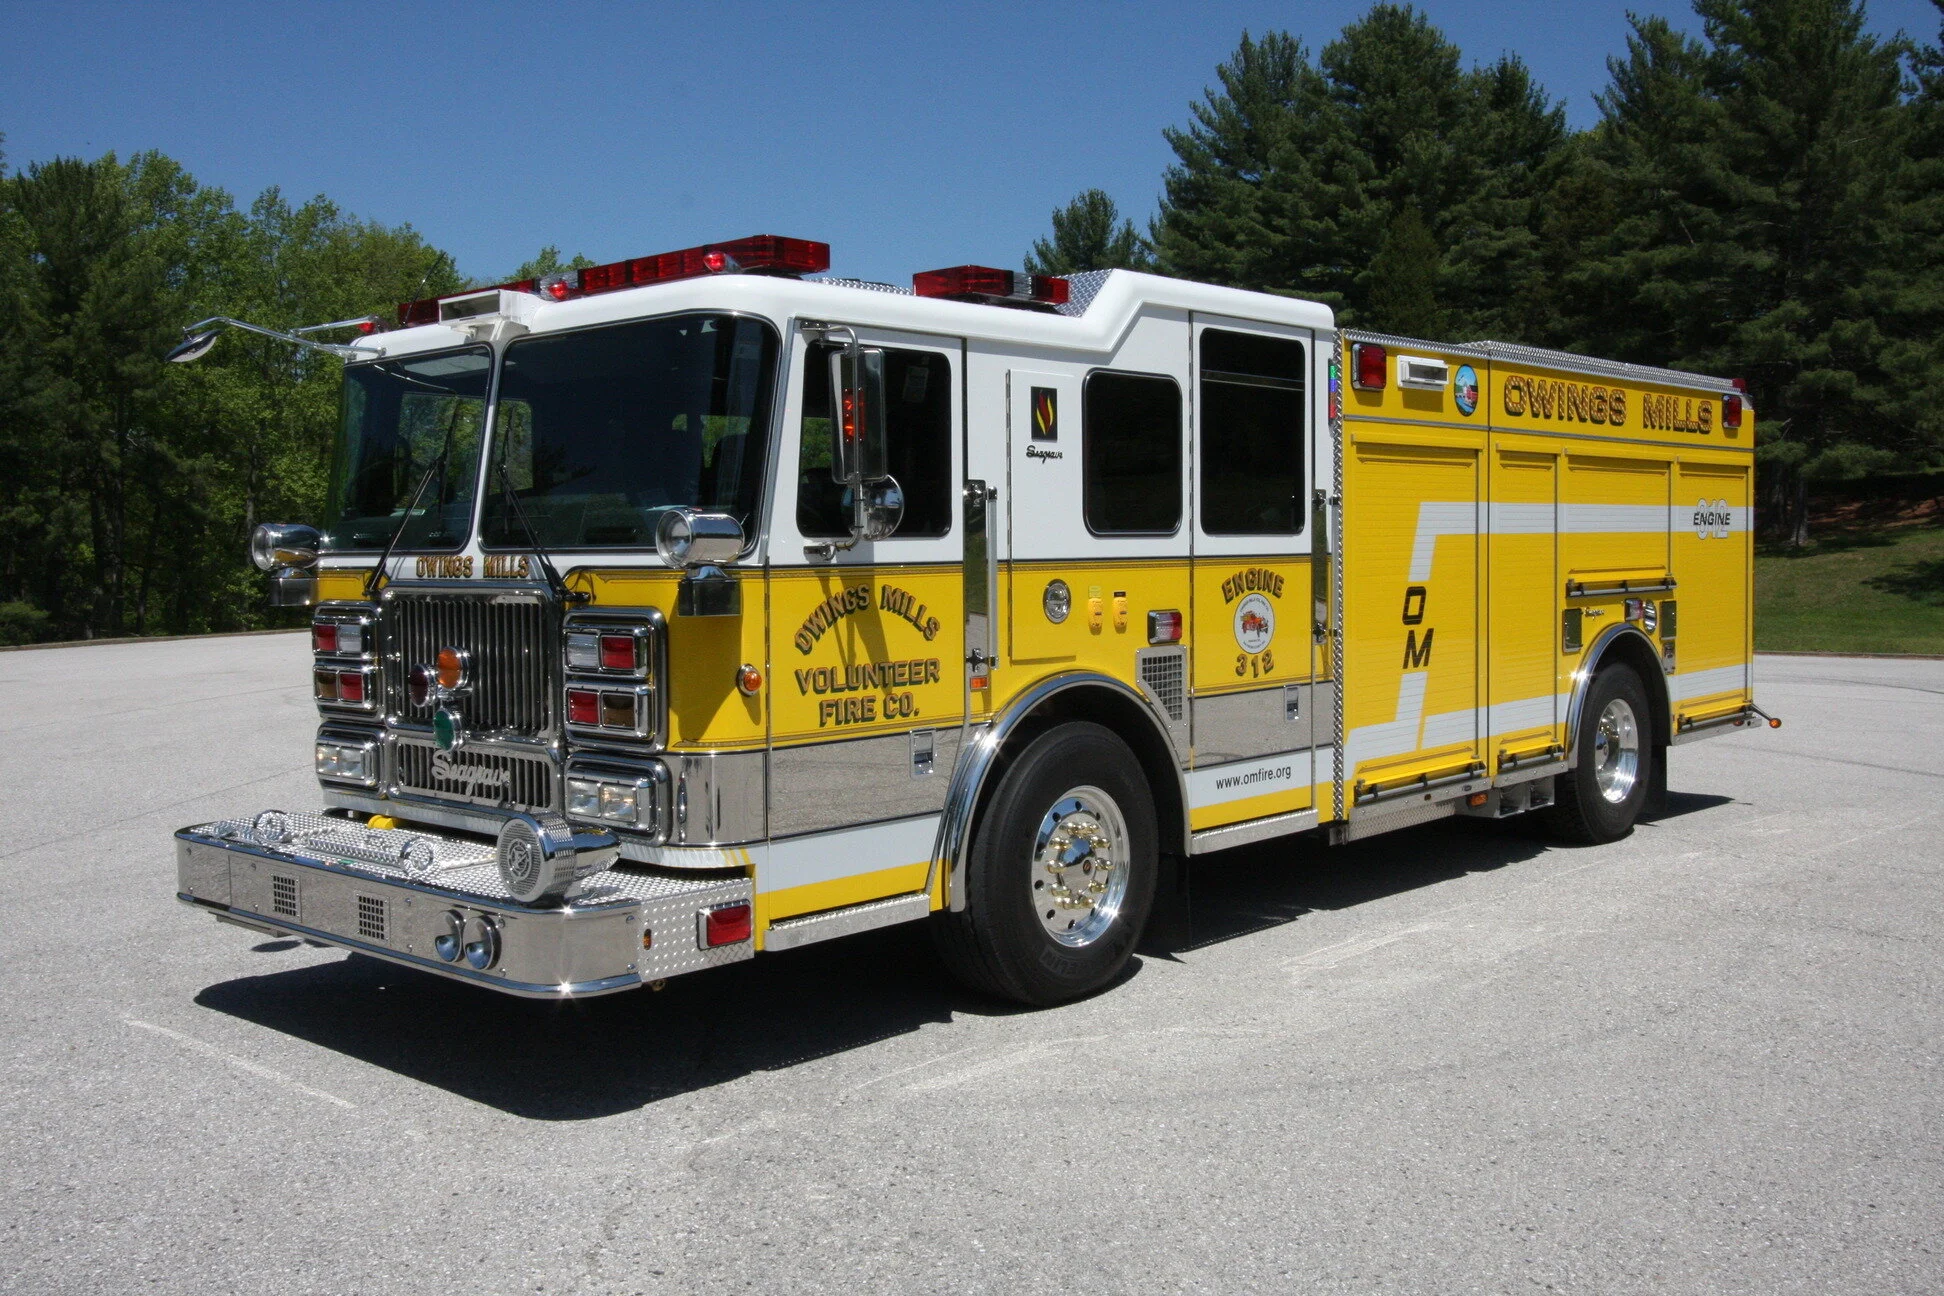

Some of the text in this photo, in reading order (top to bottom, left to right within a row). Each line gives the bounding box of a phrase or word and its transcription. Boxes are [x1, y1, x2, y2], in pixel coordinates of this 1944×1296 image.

[1504, 375, 1713, 434] OWINGS MILLS
[1693, 512, 1731, 526] ENGINE
[416, 555, 529, 578] OWINGS MILLS
[1222, 568, 1284, 604] ENGINE
[795, 584, 940, 655] OWINGS MILLS
[795, 658, 940, 696] VOLUNTEER
[1235, 650, 1274, 678] 312
[819, 692, 919, 727] FIRE CO.
[1216, 766, 1291, 789] www.omfire.org
